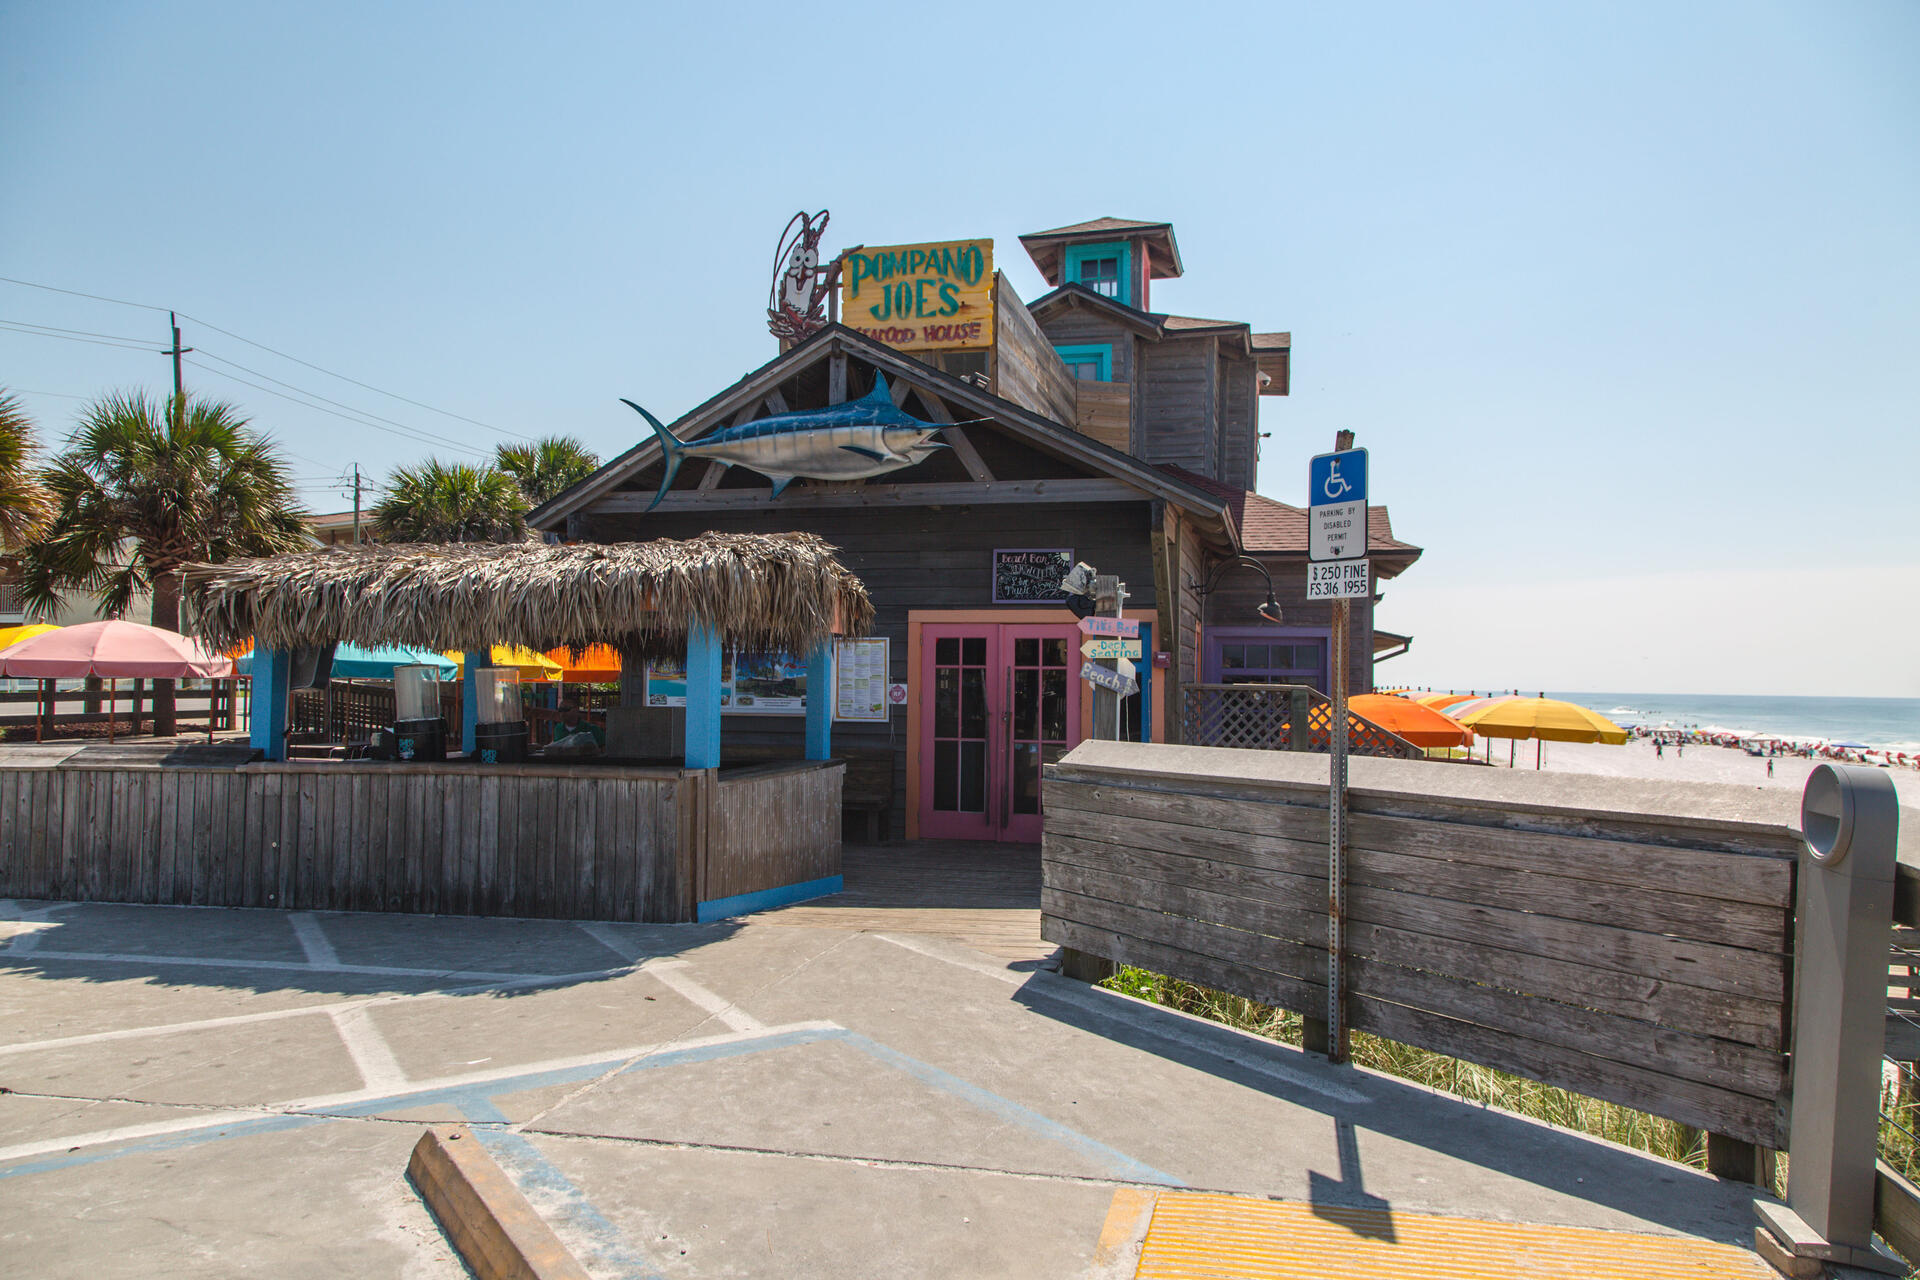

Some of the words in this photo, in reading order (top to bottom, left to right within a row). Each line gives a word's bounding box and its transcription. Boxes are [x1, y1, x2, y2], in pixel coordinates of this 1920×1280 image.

[848, 245, 984, 299] POMPANO
[869, 277, 960, 321] JOE'S
[923, 321, 981, 343] HOUSE
[1319, 508, 1343, 518] PARKING
[1348, 507, 1355, 515] BY
[1323, 519, 1351, 530] DISABLED
[1327, 532, 1347, 541] PERMIT
[1330, 545, 1344, 554] OY
[1321, 566, 1341, 580] 250
[1344, 564, 1367, 579] FINE
[1116, 621, 1138, 633] Bar
[1101, 641, 1126, 650] Deck
[1080, 662, 1120, 689] Beach
